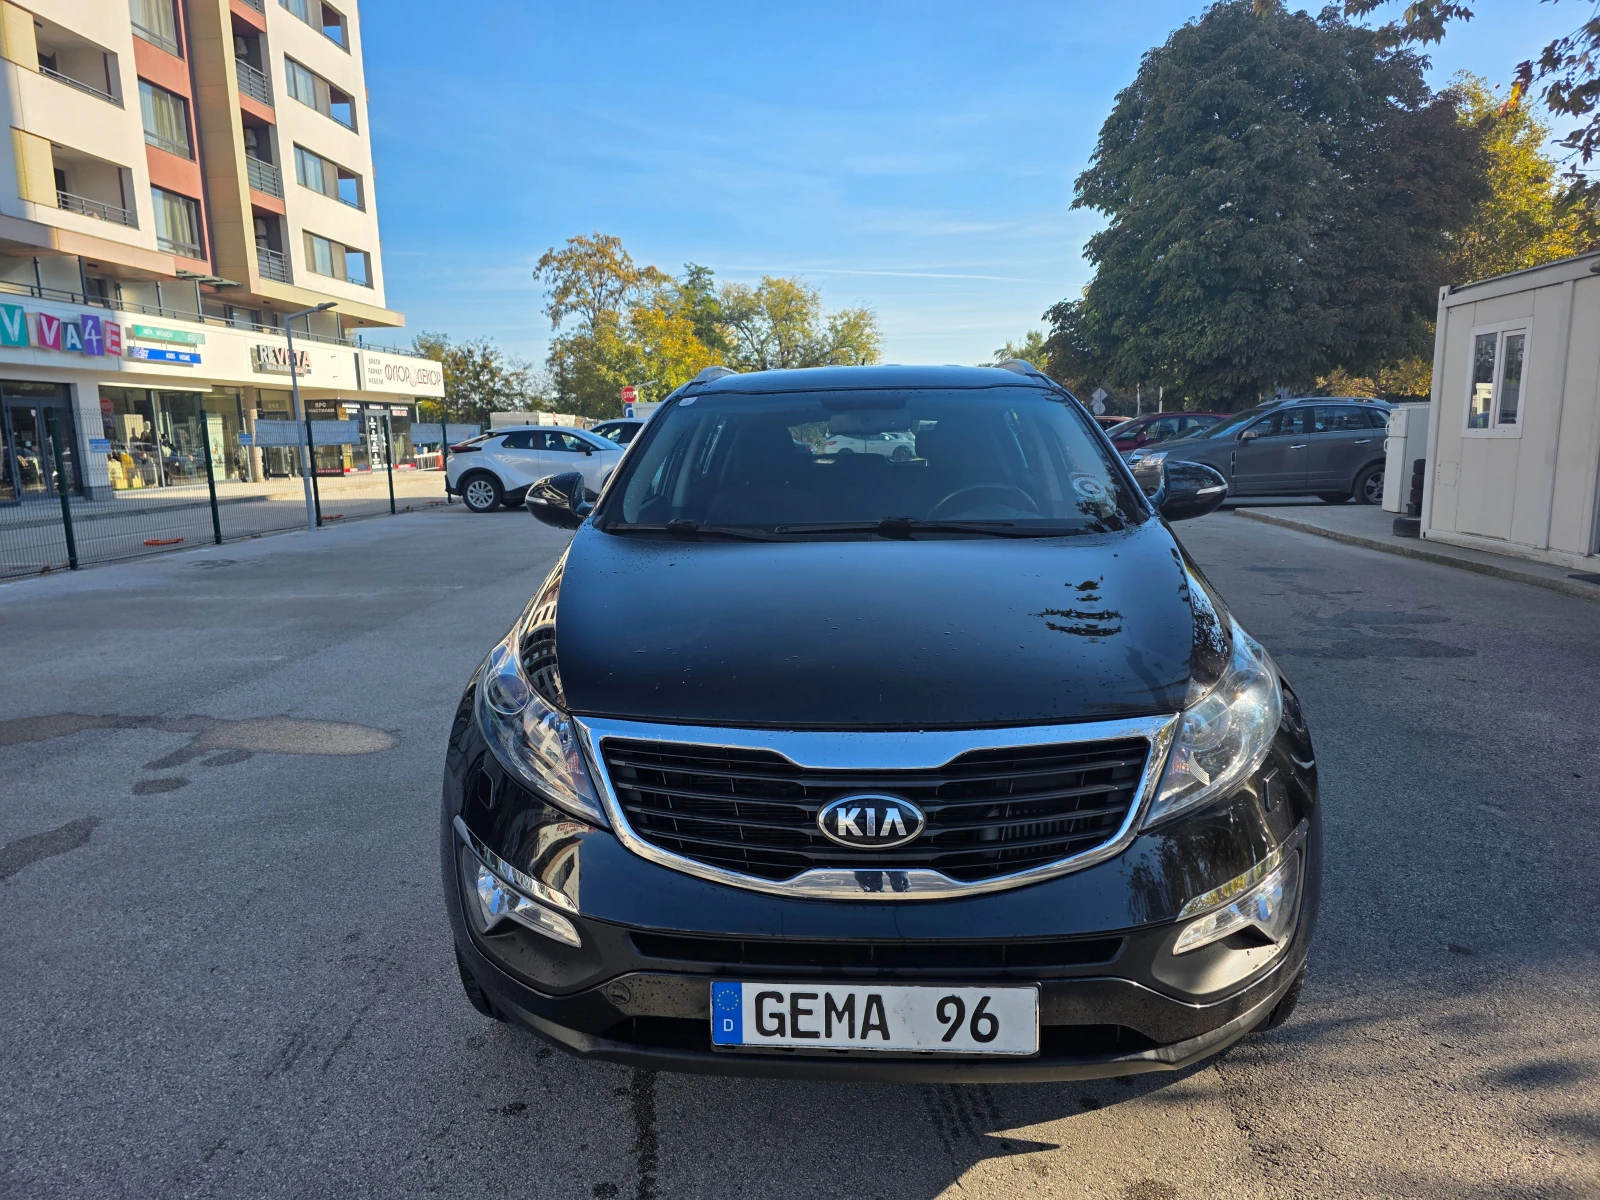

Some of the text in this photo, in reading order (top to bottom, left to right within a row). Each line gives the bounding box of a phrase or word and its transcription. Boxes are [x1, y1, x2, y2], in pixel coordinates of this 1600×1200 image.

[156, 329, 173, 338] WOMEN
[836, 807, 907, 836] KIA
[722, 1018, 734, 1032] D
[754, 990, 1000, 1043] GEMA 96
